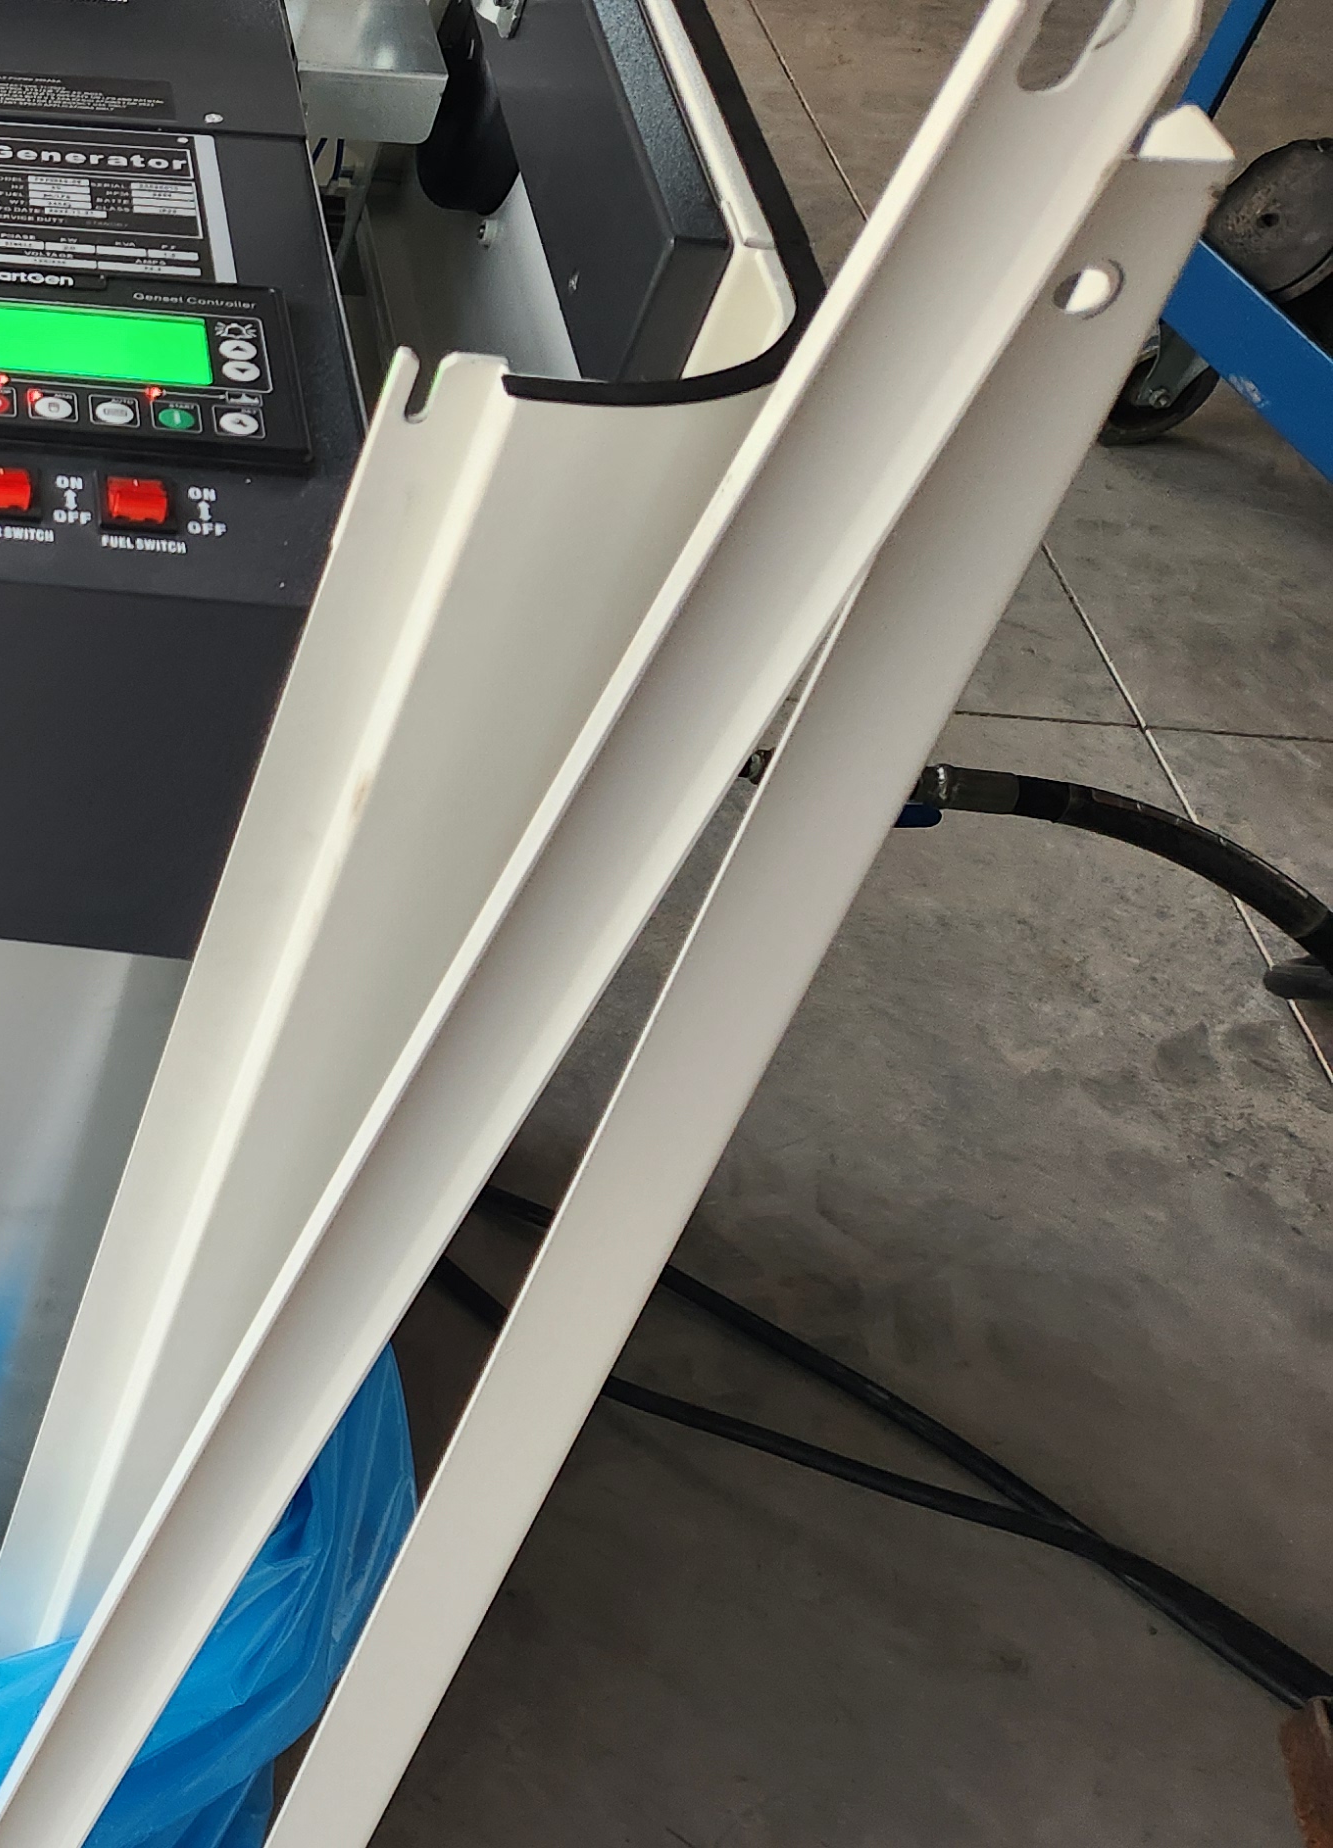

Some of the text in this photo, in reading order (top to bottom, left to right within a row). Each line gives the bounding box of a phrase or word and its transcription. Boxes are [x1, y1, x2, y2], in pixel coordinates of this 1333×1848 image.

[24, 250, 74, 259] VOLTAGE
[133, 292, 257, 309] Genset Controller
[55, 475, 83, 490] ON
[187, 486, 216, 501] ON
[53, 509, 92, 525] OFF
[3, 525, 55, 543] SWITCH
[187, 521, 227, 537] OFF
[100, 534, 187, 554] FUEL SWITCH
